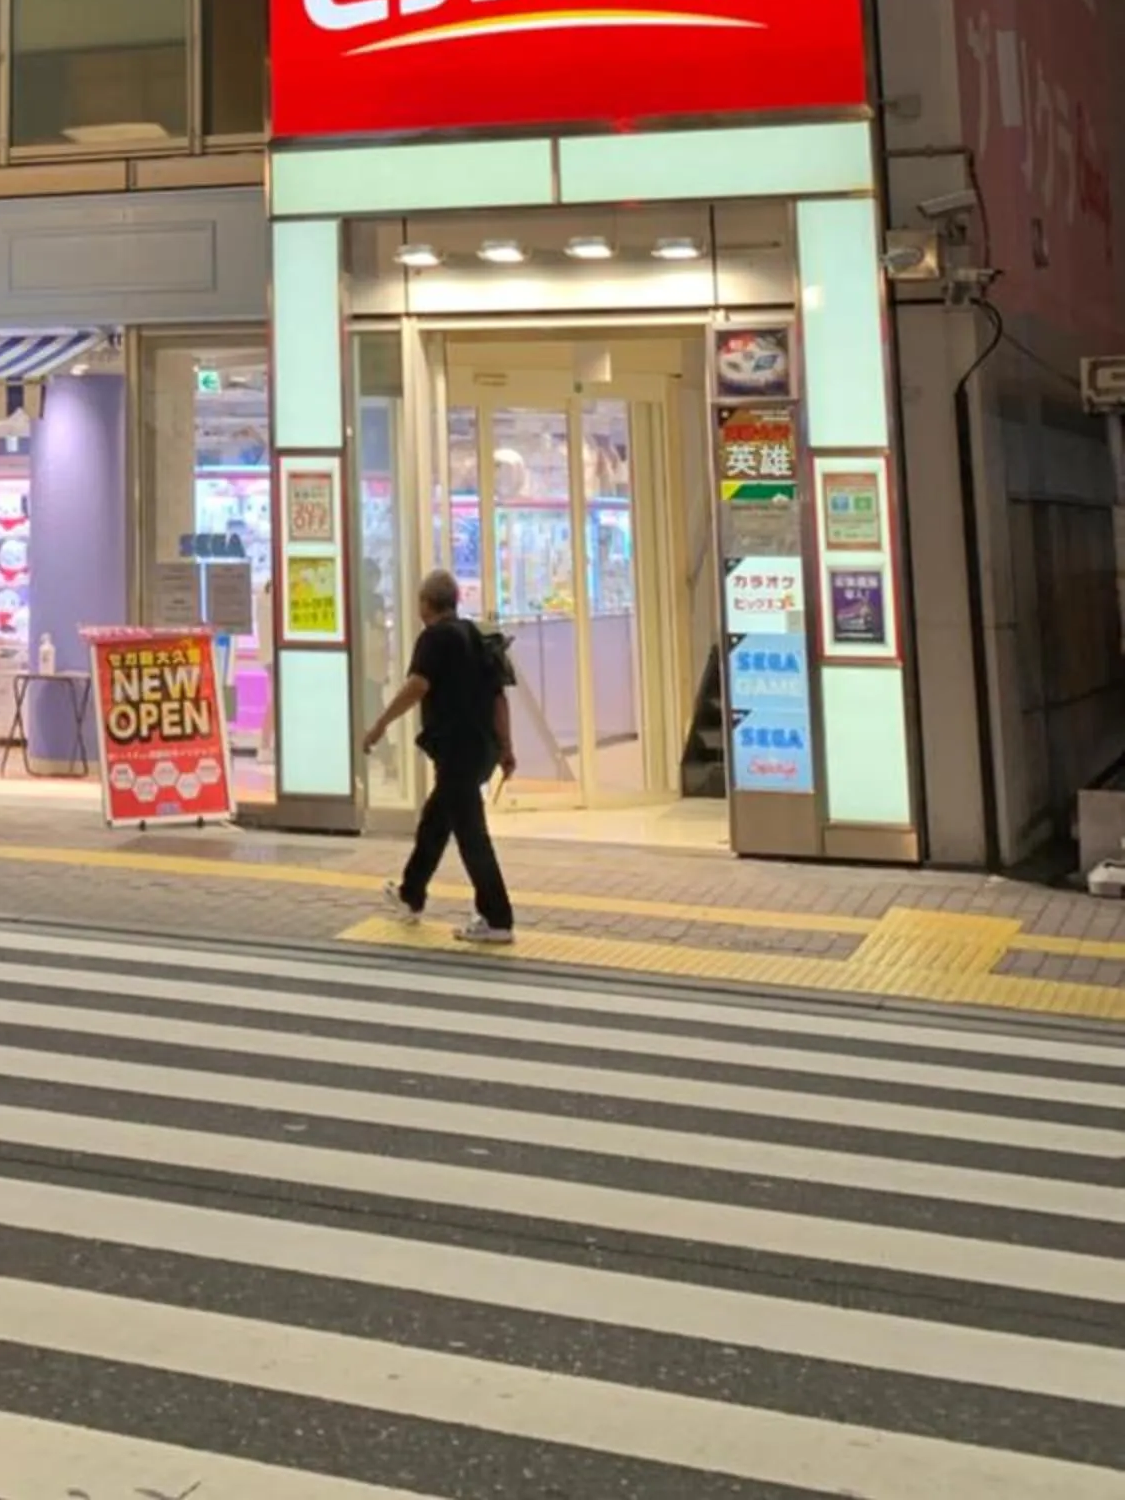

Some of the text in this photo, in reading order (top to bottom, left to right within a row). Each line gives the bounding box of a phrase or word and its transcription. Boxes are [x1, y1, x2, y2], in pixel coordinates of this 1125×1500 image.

[725, 444, 793, 477] 英雄
[733, 574, 795, 590] カラオケ
[737, 651, 800, 674] SEGA
[113, 666, 200, 703] NEW
[108, 700, 211, 740] OPEN
[741, 726, 804, 750] SEGA
